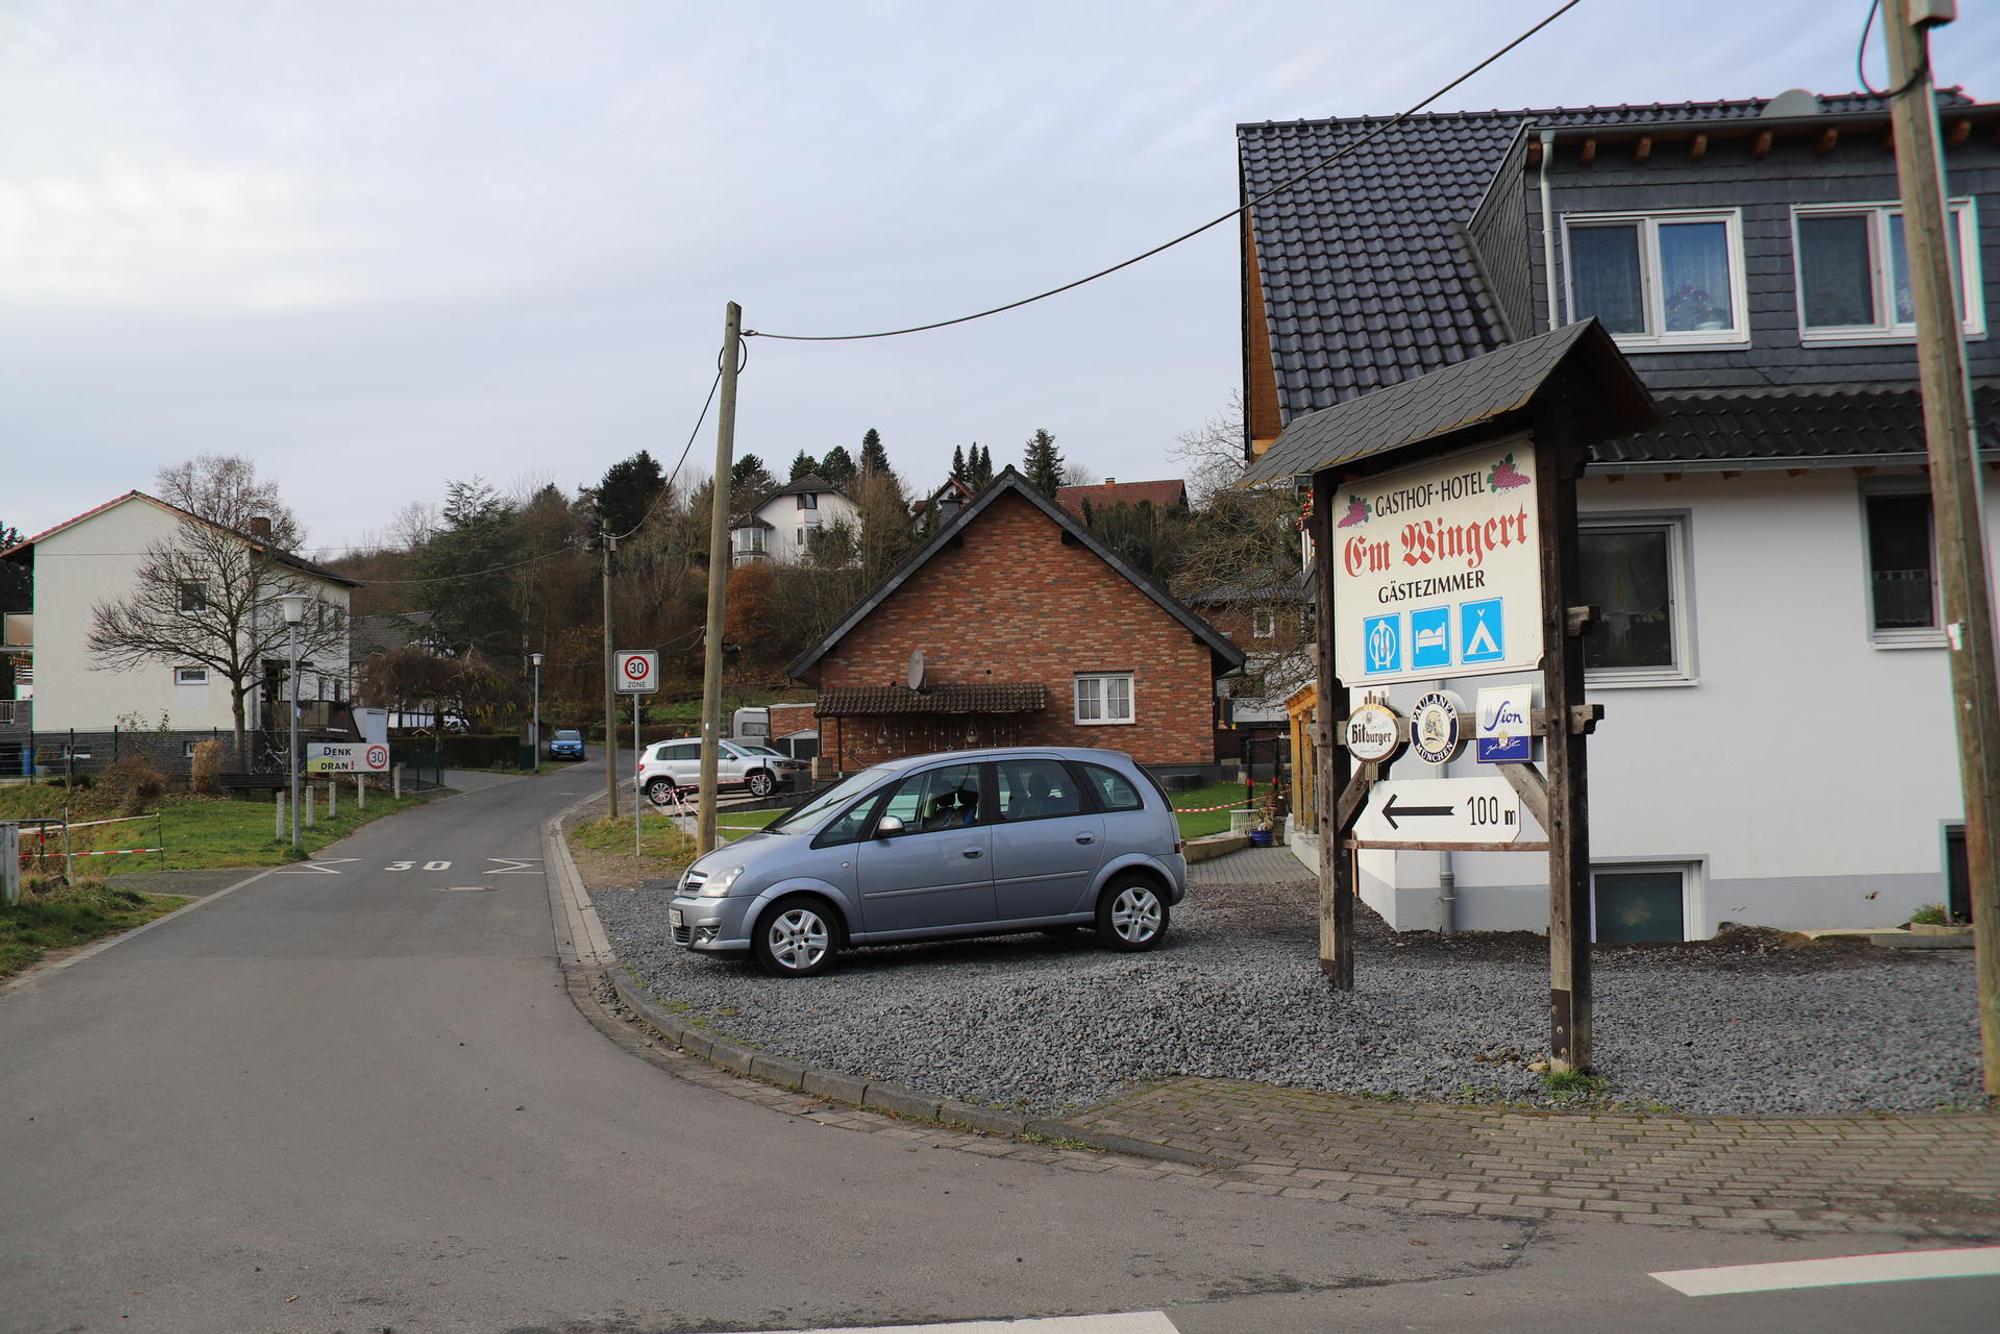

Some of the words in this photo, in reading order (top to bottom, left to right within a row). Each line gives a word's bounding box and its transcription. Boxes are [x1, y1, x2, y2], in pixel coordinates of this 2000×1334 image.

[1344, 535, 1391, 577] Em
[1401, 501, 1528, 569] Wingert
[1378, 569, 1485, 604] GÄSTEZIMMER
[630, 662, 644, 674] 30
[1412, 694, 1456, 723] PAULANER
[1483, 700, 1523, 732] Sion
[1351, 722, 1392, 746] Bitburger
[370, 751, 384, 763] 30
[1415, 742, 1453, 763] MÜNCHEN
[1467, 796, 1498, 826] 100
[1504, 809, 1517, 825] m
[384, 860, 452, 871] 30
